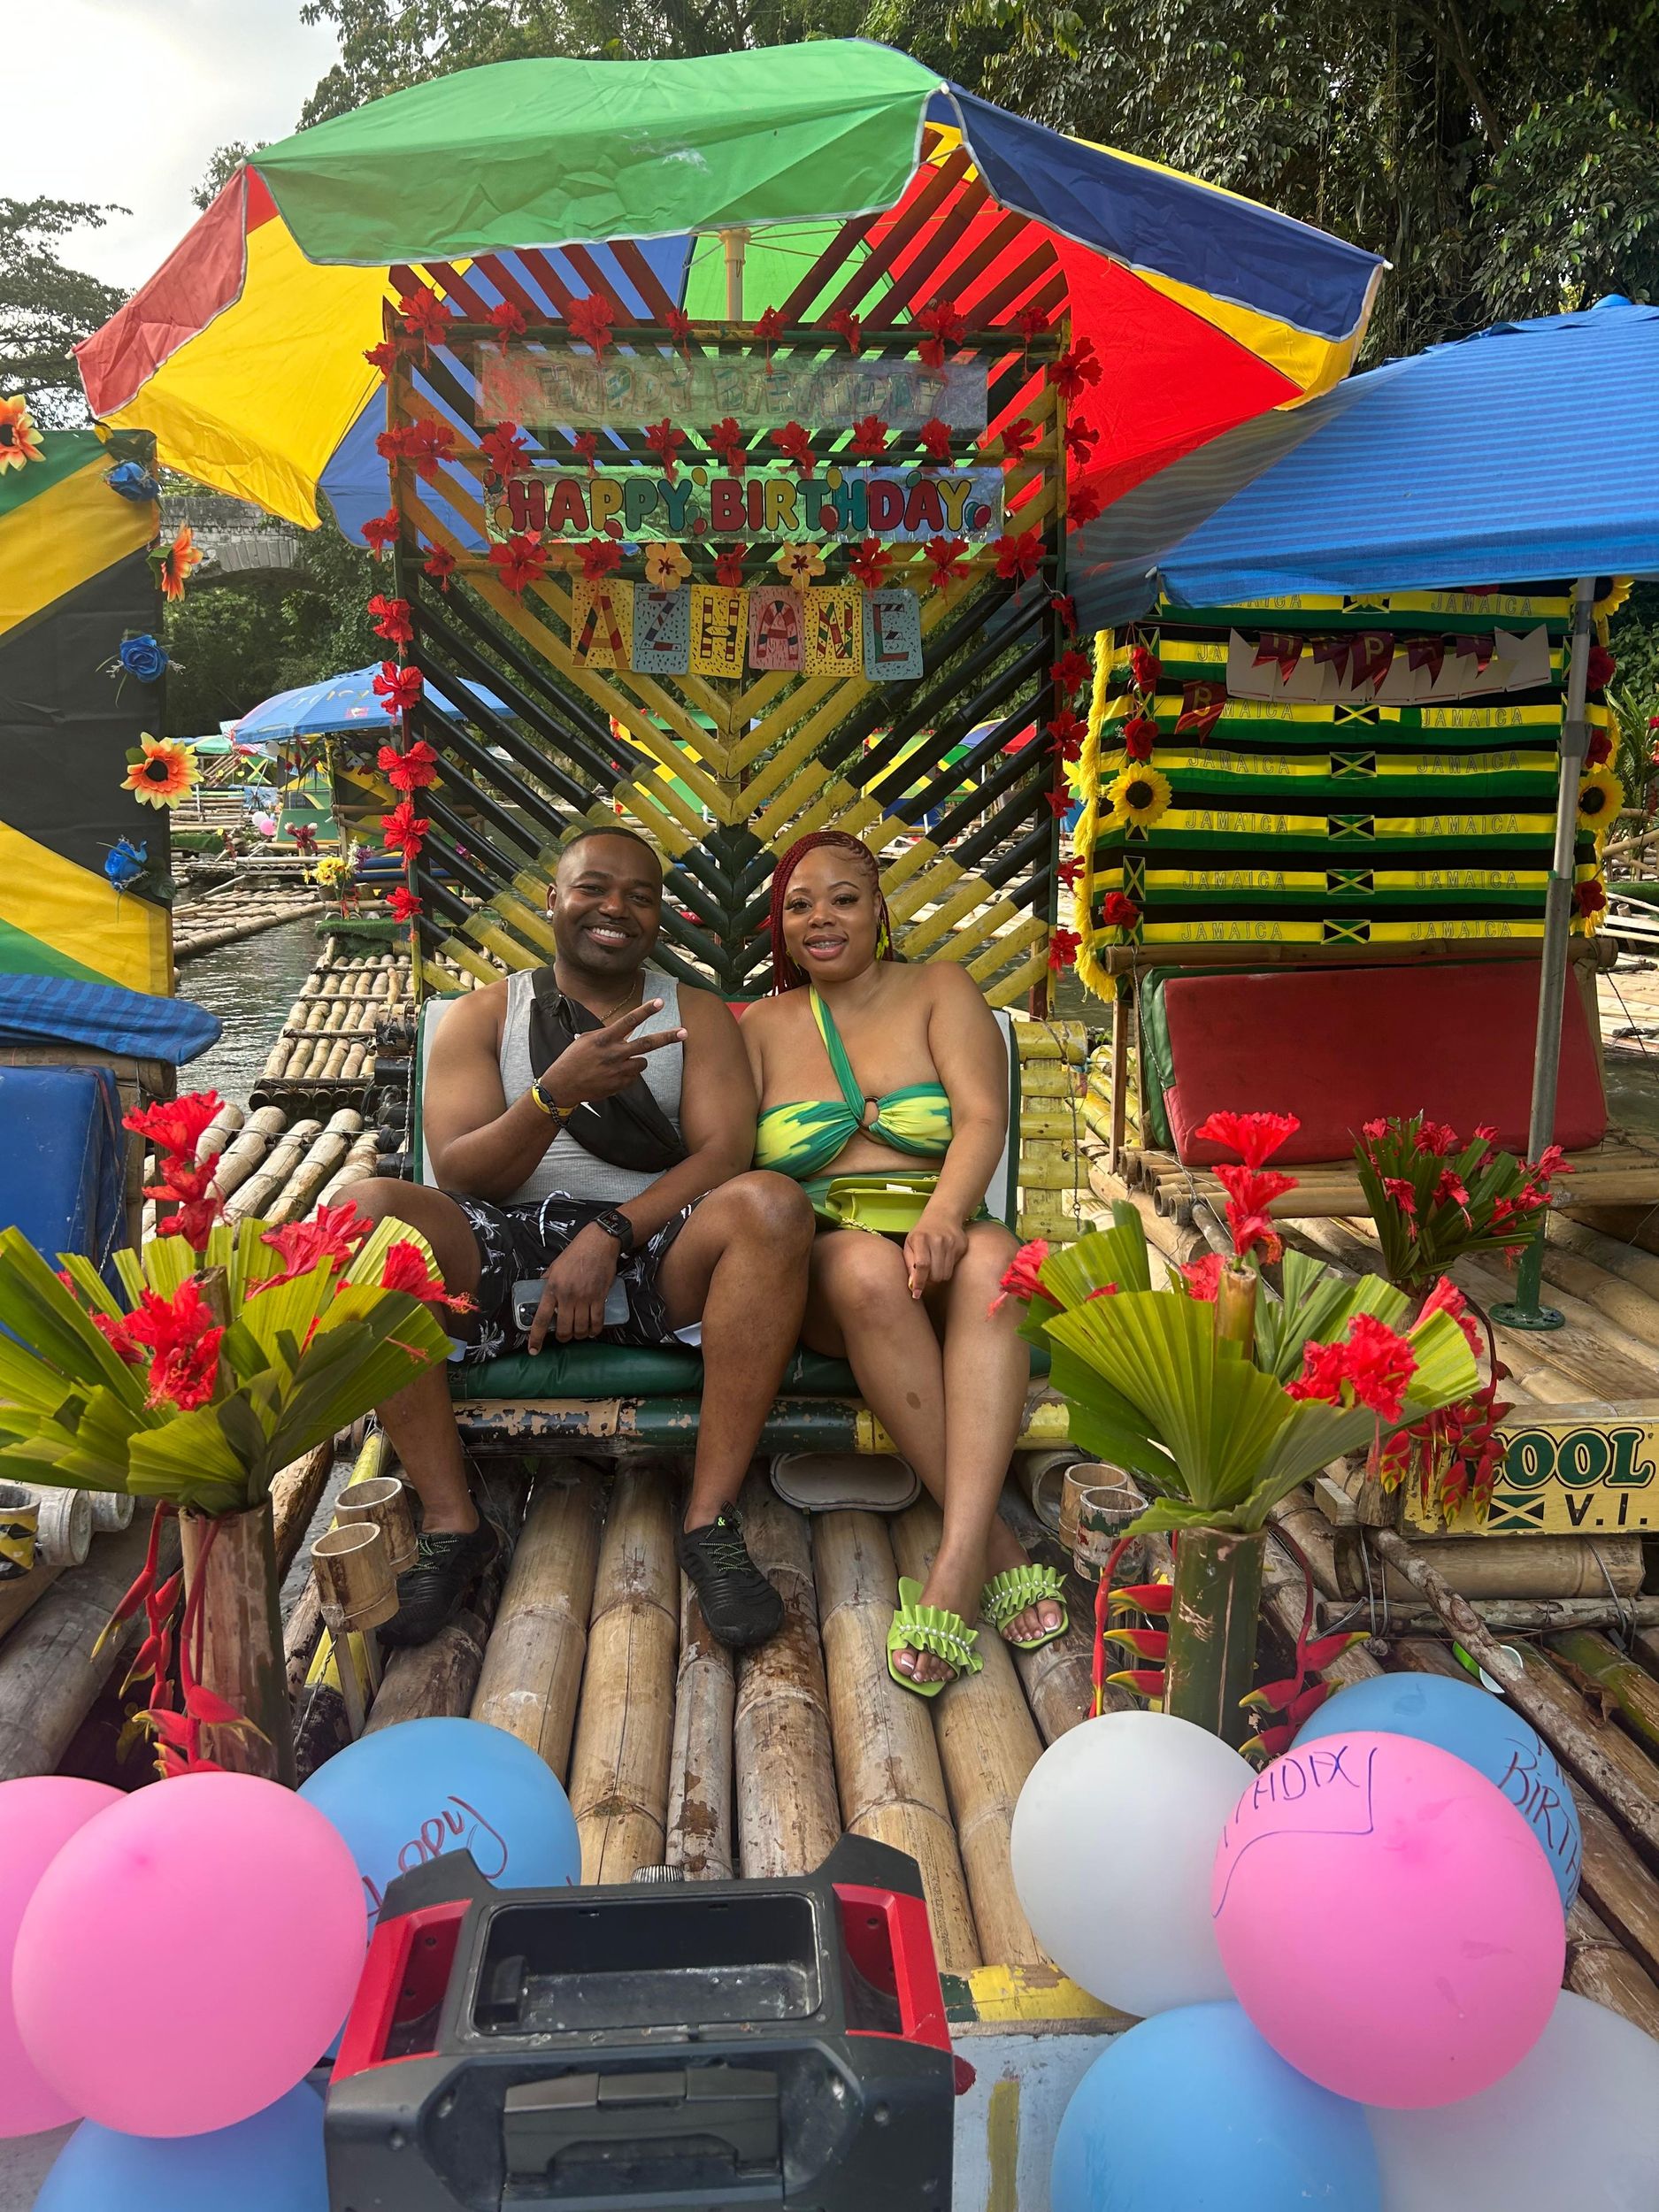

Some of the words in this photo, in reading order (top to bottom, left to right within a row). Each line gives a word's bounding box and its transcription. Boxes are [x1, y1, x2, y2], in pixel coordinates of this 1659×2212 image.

[508, 479, 692, 532] HAPPY
[710, 479, 972, 533] BIRTHDAY
[1431, 594, 1532, 616] JAMAICA
[572, 592, 910, 668] AZHANE
[1223, 701, 1294, 719] MAICA
[1422, 708, 1523, 727] JAMAICA
[1188, 749, 1290, 774] JAMAICA
[1417, 751, 1520, 774] JAMAICA
[1186, 810, 1288, 833] JAMAICA
[1416, 814, 1519, 835] JAMAICA
[1182, 872, 1286, 890] JAMAICA
[1415, 871, 1518, 889] JAMAICA
[1181, 921, 1283, 941] JAMAICA
[1410, 920, 1512, 940] JAMAICA
[1449, 1426, 1656, 1491] OOL
